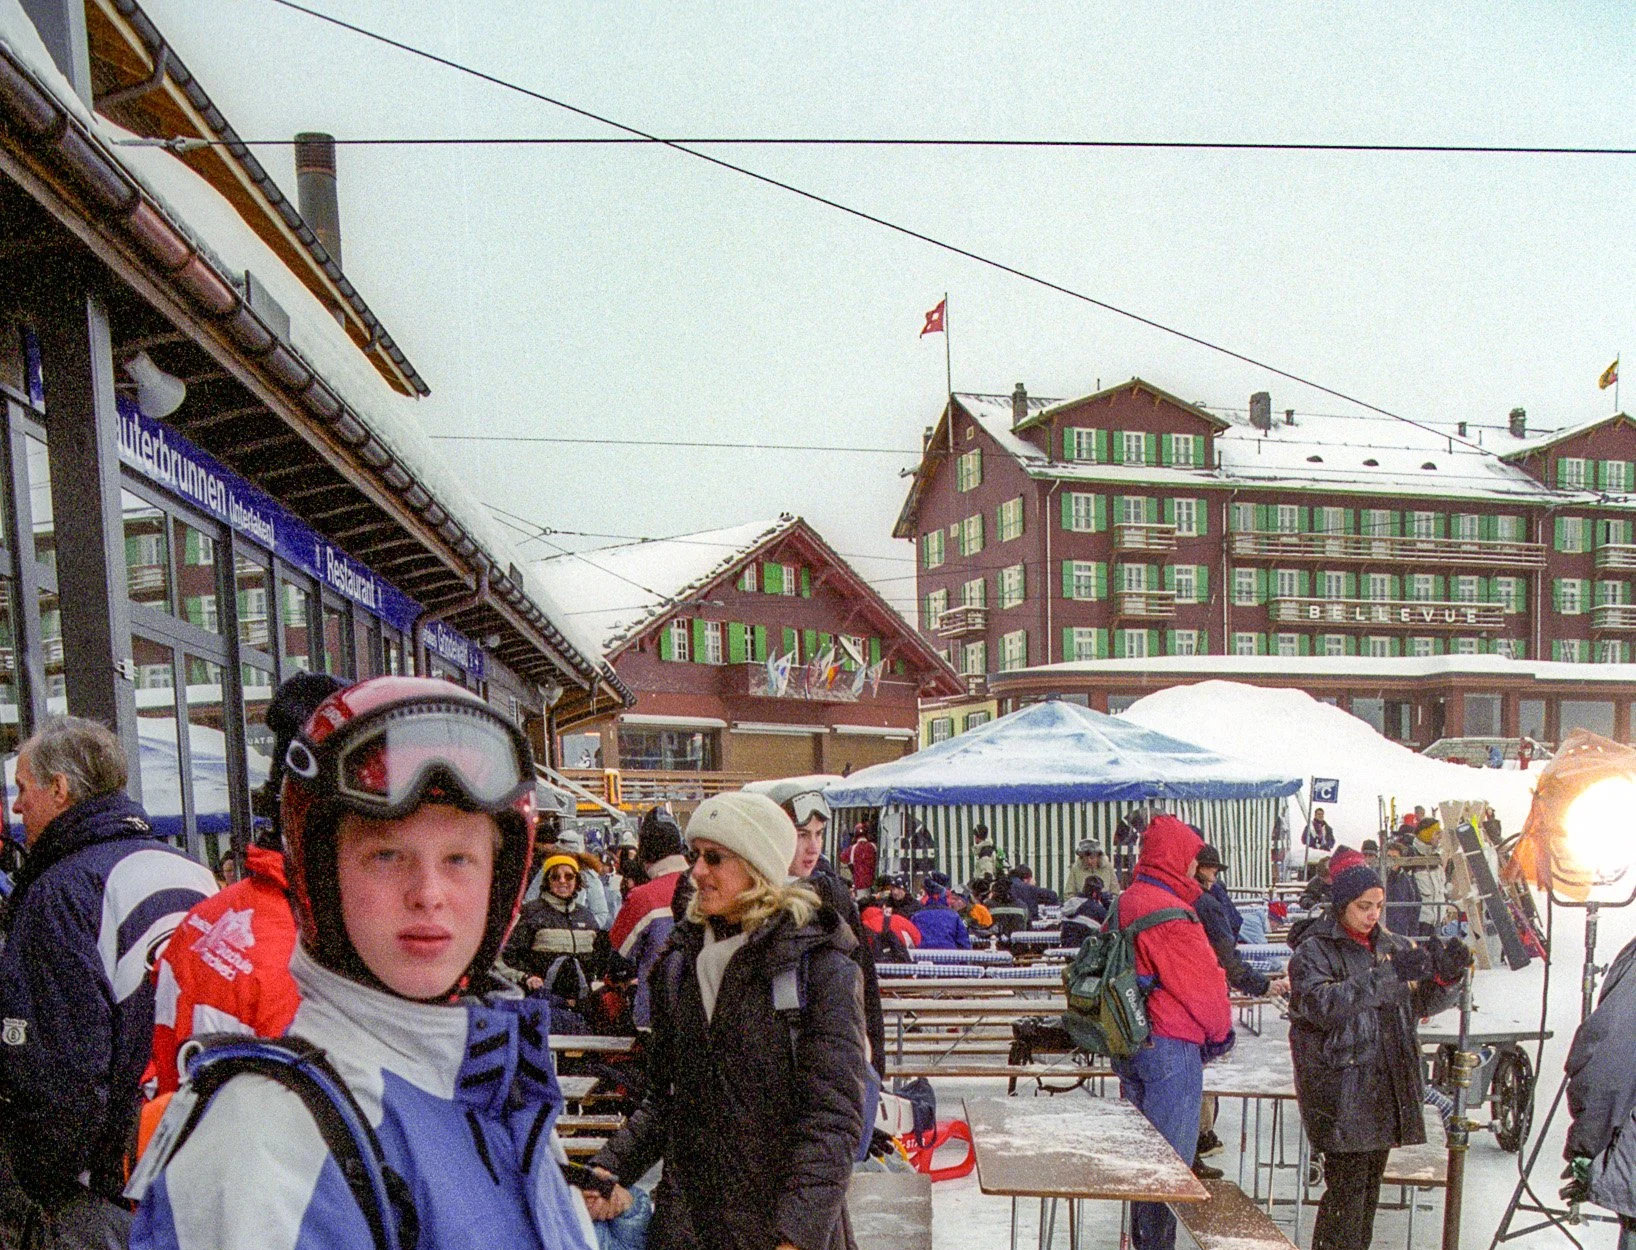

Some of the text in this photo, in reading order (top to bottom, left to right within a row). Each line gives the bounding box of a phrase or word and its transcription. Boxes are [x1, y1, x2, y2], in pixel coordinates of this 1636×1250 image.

[115, 411, 227, 516] auterbrunnen
[326, 546, 376, 609] Restaurant
[1308, 605, 1477, 624] BELLEVUE
[1320, 786, 1332, 799] C
